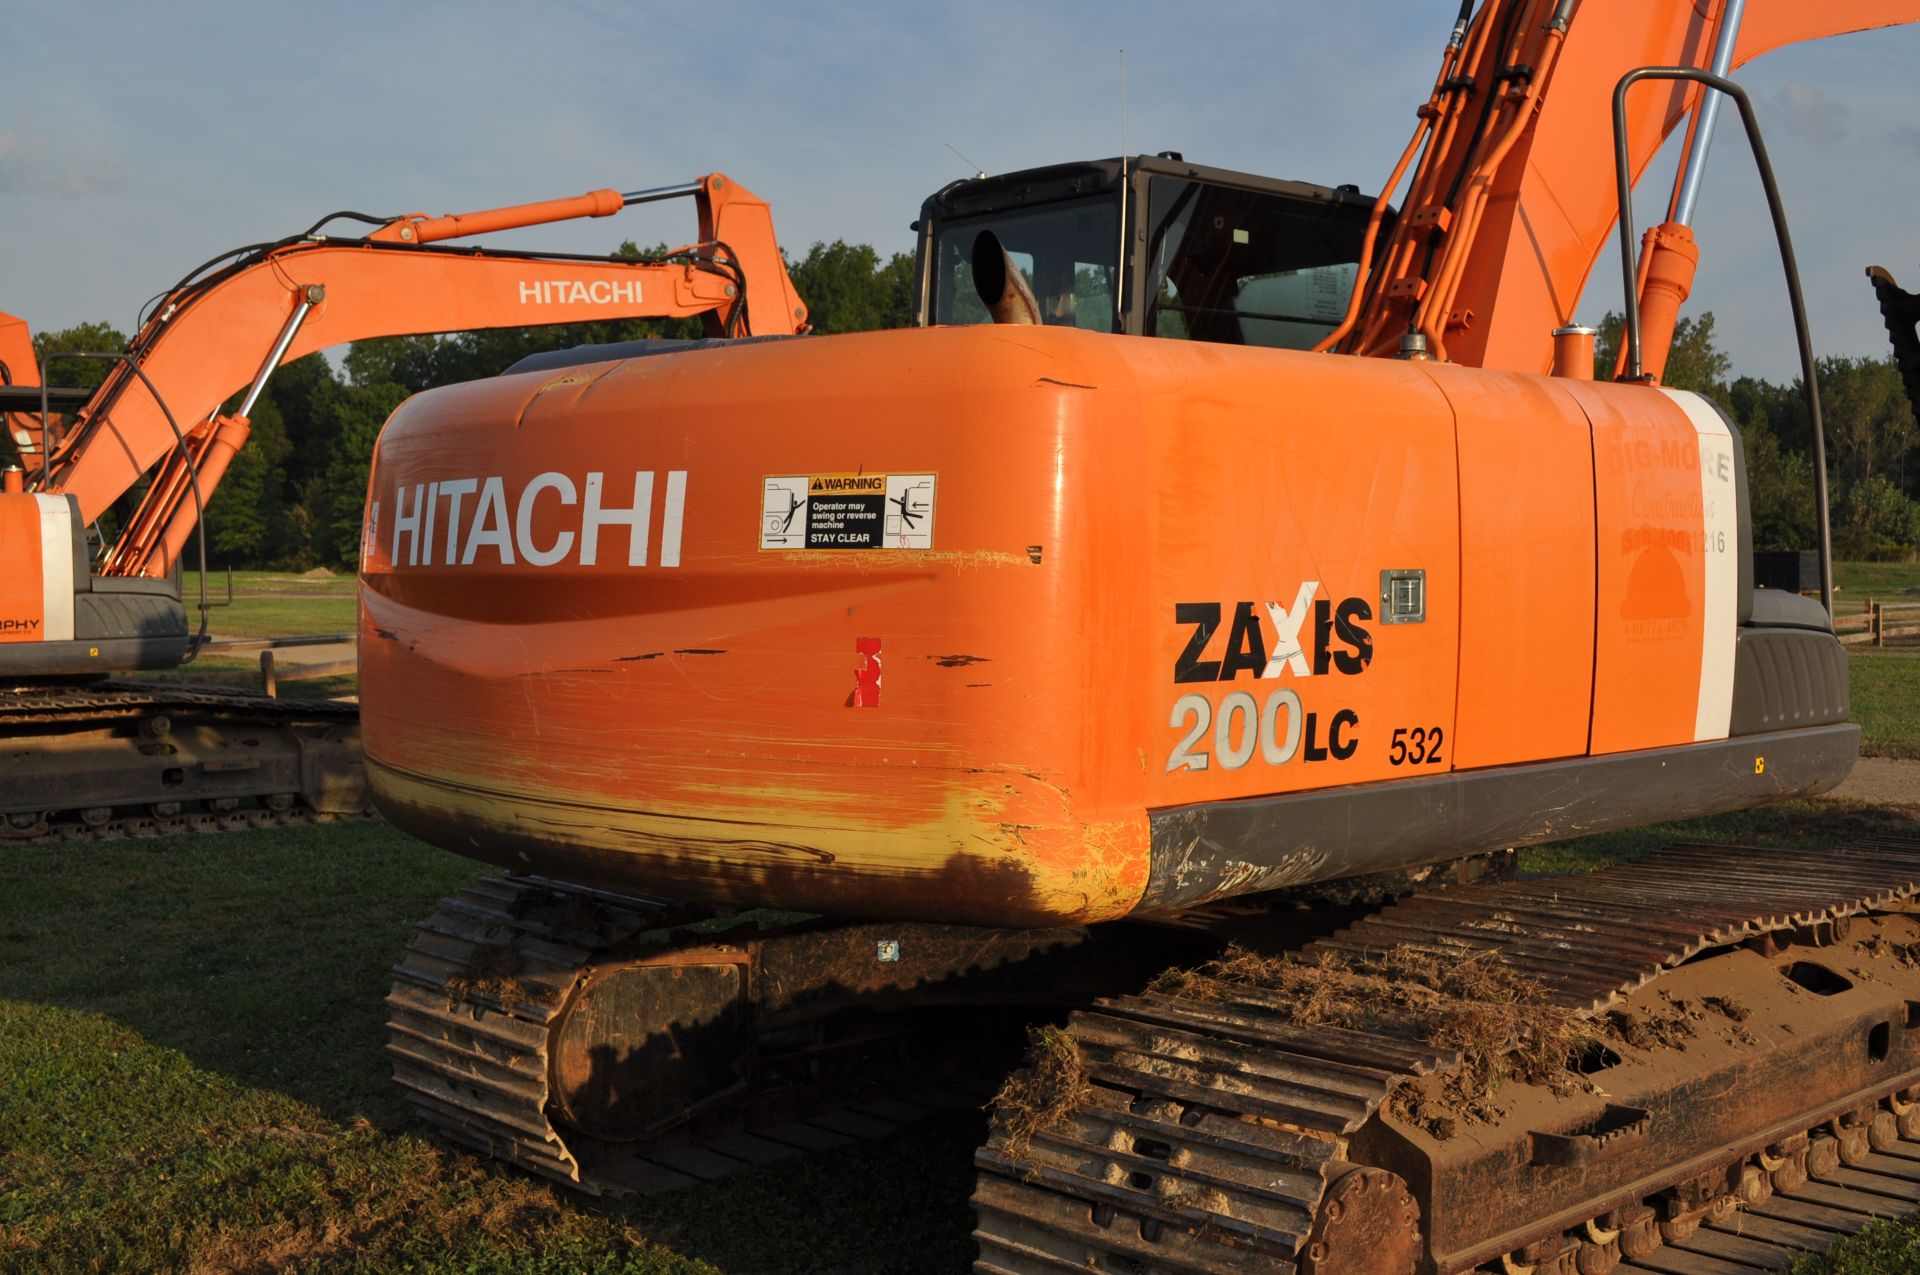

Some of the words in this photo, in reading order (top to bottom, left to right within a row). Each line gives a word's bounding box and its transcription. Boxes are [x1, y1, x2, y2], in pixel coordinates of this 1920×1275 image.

[519, 280, 643, 304] HITACHI
[825, 478, 882, 489] WARNING
[813, 502, 847, 511] Operator
[848, 503, 865, 511] may
[391, 470, 688, 567] HITACHI
[812, 512, 835, 521] swing
[837, 512, 845, 520] or
[847, 512, 877, 520] reverse
[812, 521, 844, 529] machine
[811, 533, 835, 543] STAY
[837, 533, 870, 543] CLEAR
[0, 619, 40, 629] PHY
[1174, 579, 1374, 684] ZAXIS
[1388, 726, 1444, 766] 532
